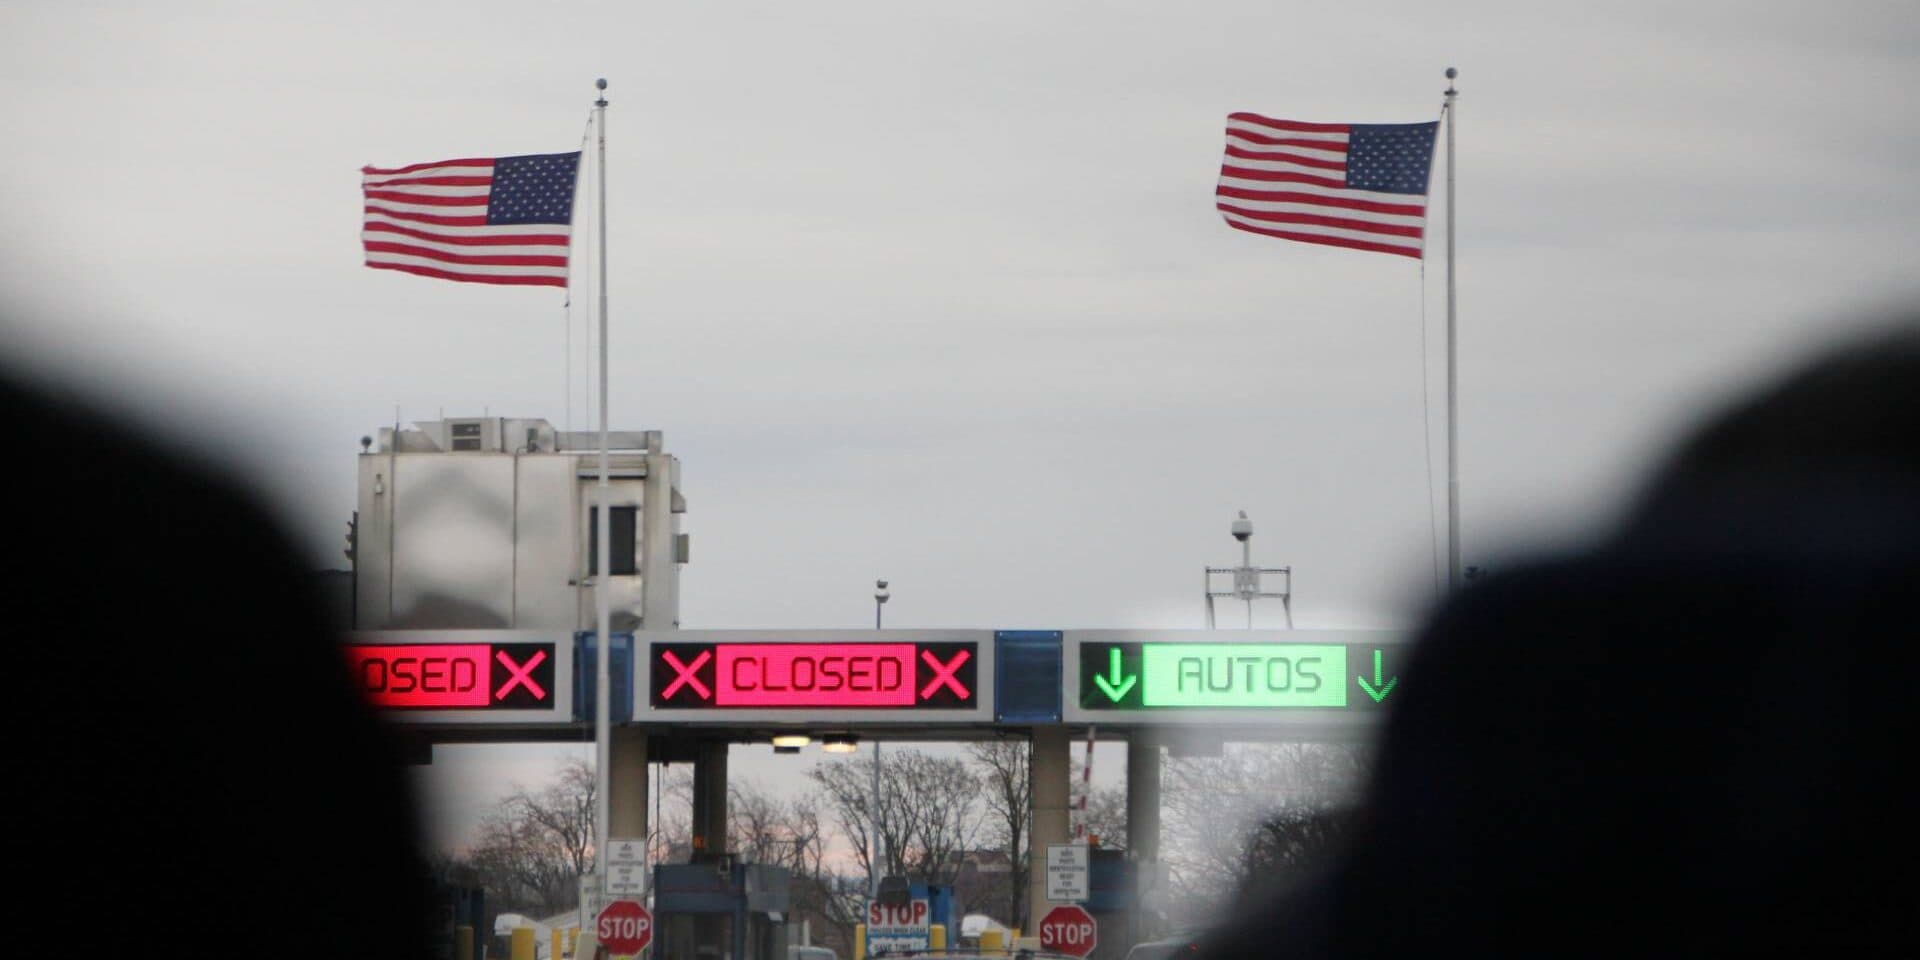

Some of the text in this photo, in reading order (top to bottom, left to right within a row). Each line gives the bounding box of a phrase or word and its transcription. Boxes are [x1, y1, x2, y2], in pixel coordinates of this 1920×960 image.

[361, 657, 476, 693] OSED
[732, 656, 902, 692] CLOSED
[1178, 656, 1322, 693] AUTOS
[870, 901, 926, 925] STOP
[601, 918, 649, 939] STOP
[1042, 923, 1093, 945] STOP
